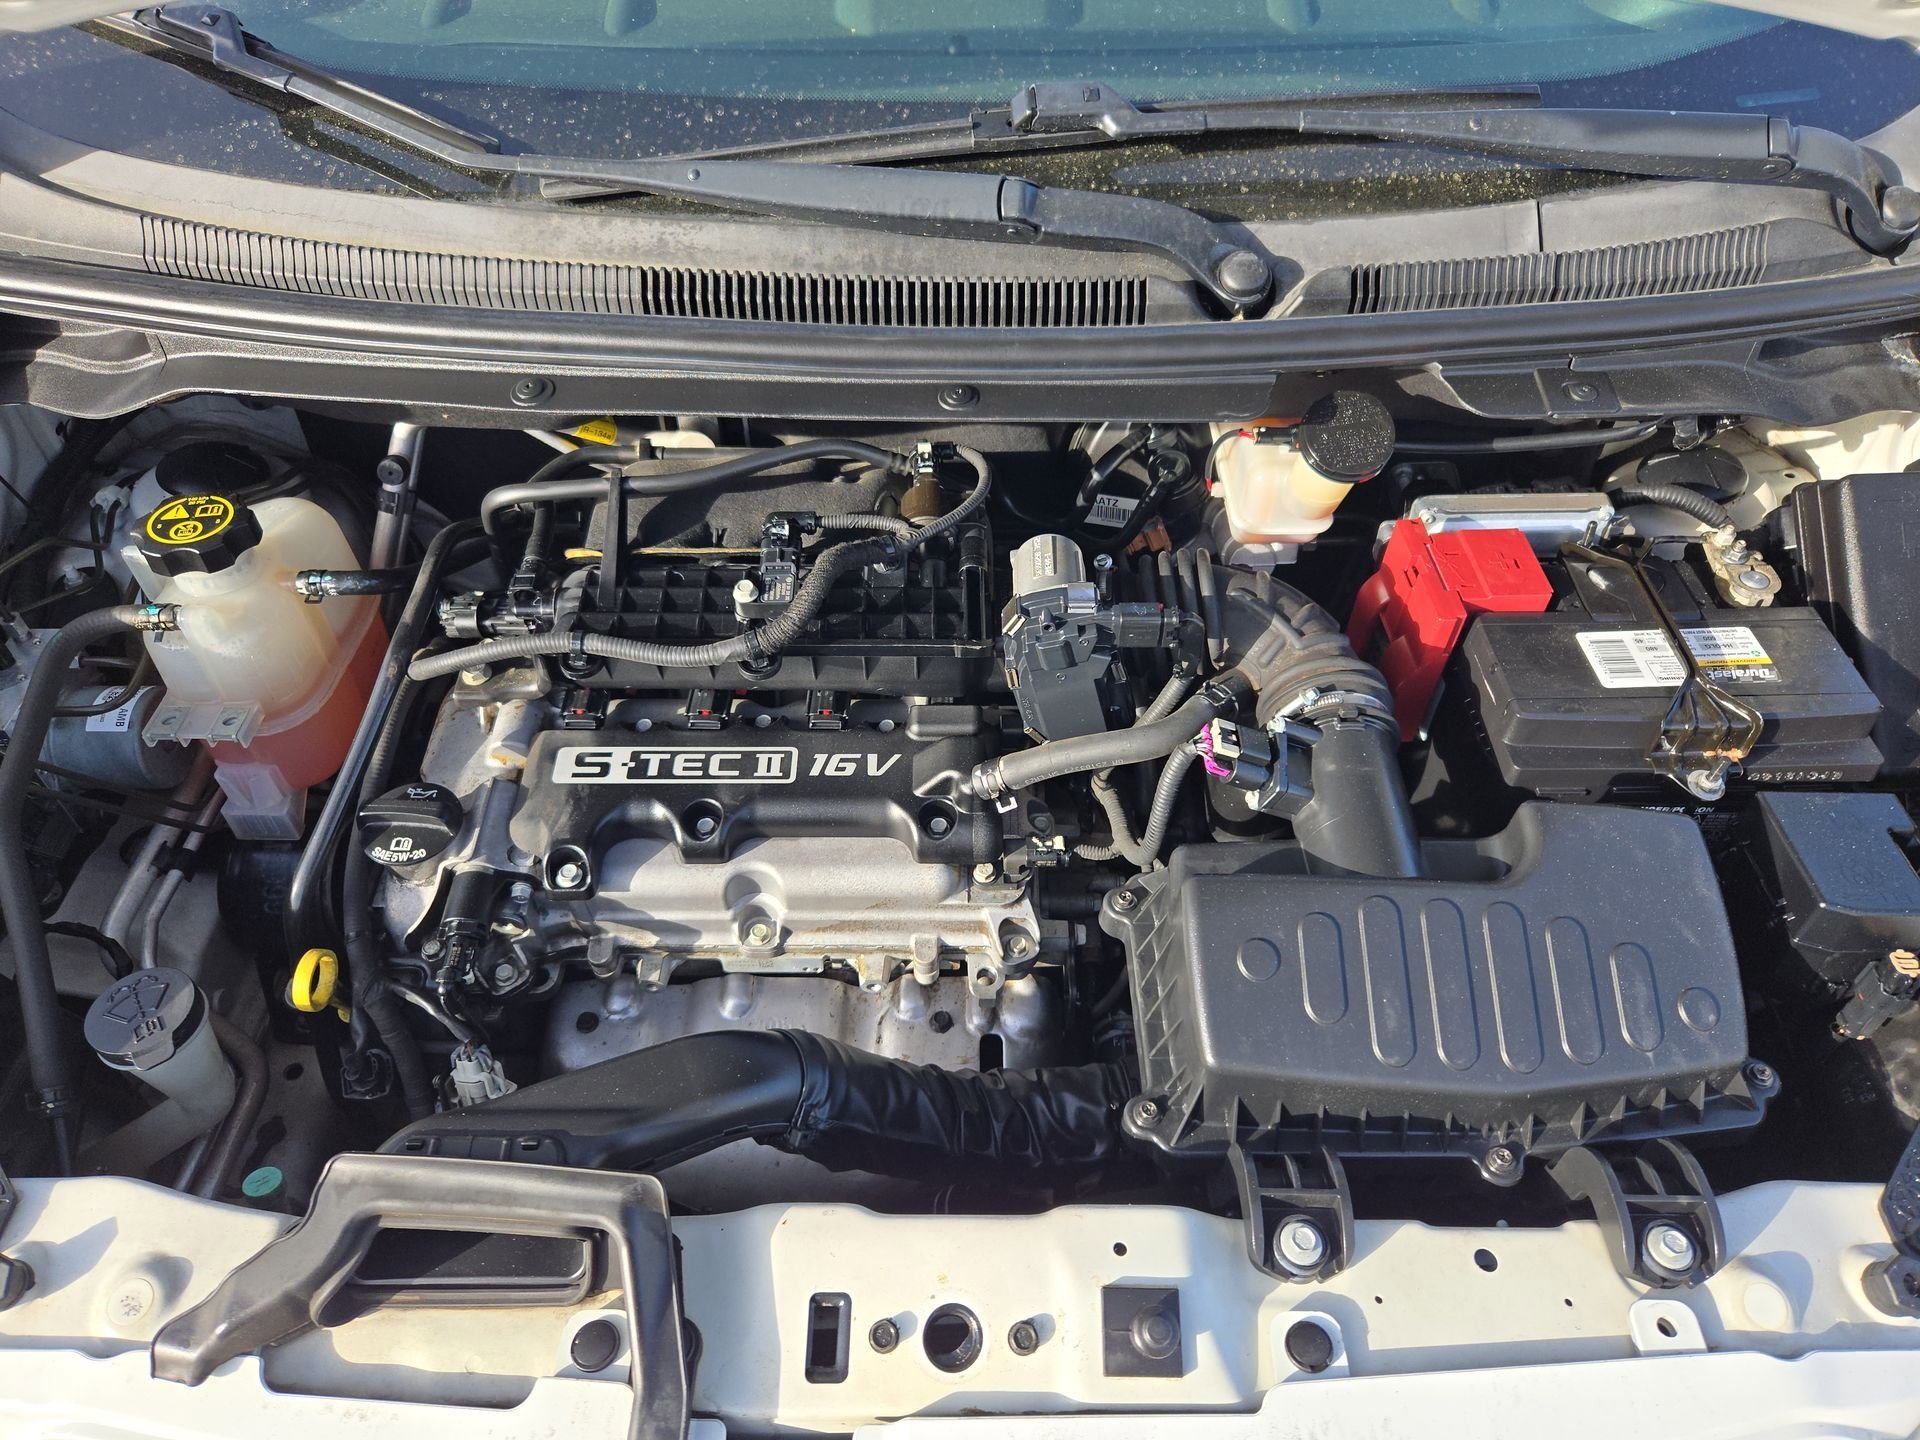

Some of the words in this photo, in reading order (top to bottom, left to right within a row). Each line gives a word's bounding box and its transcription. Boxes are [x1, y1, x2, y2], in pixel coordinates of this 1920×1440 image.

[583, 426, 612, 439] R-134a
[1707, 668, 1775, 680] Duralast
[808, 753, 902, 777] 16V
